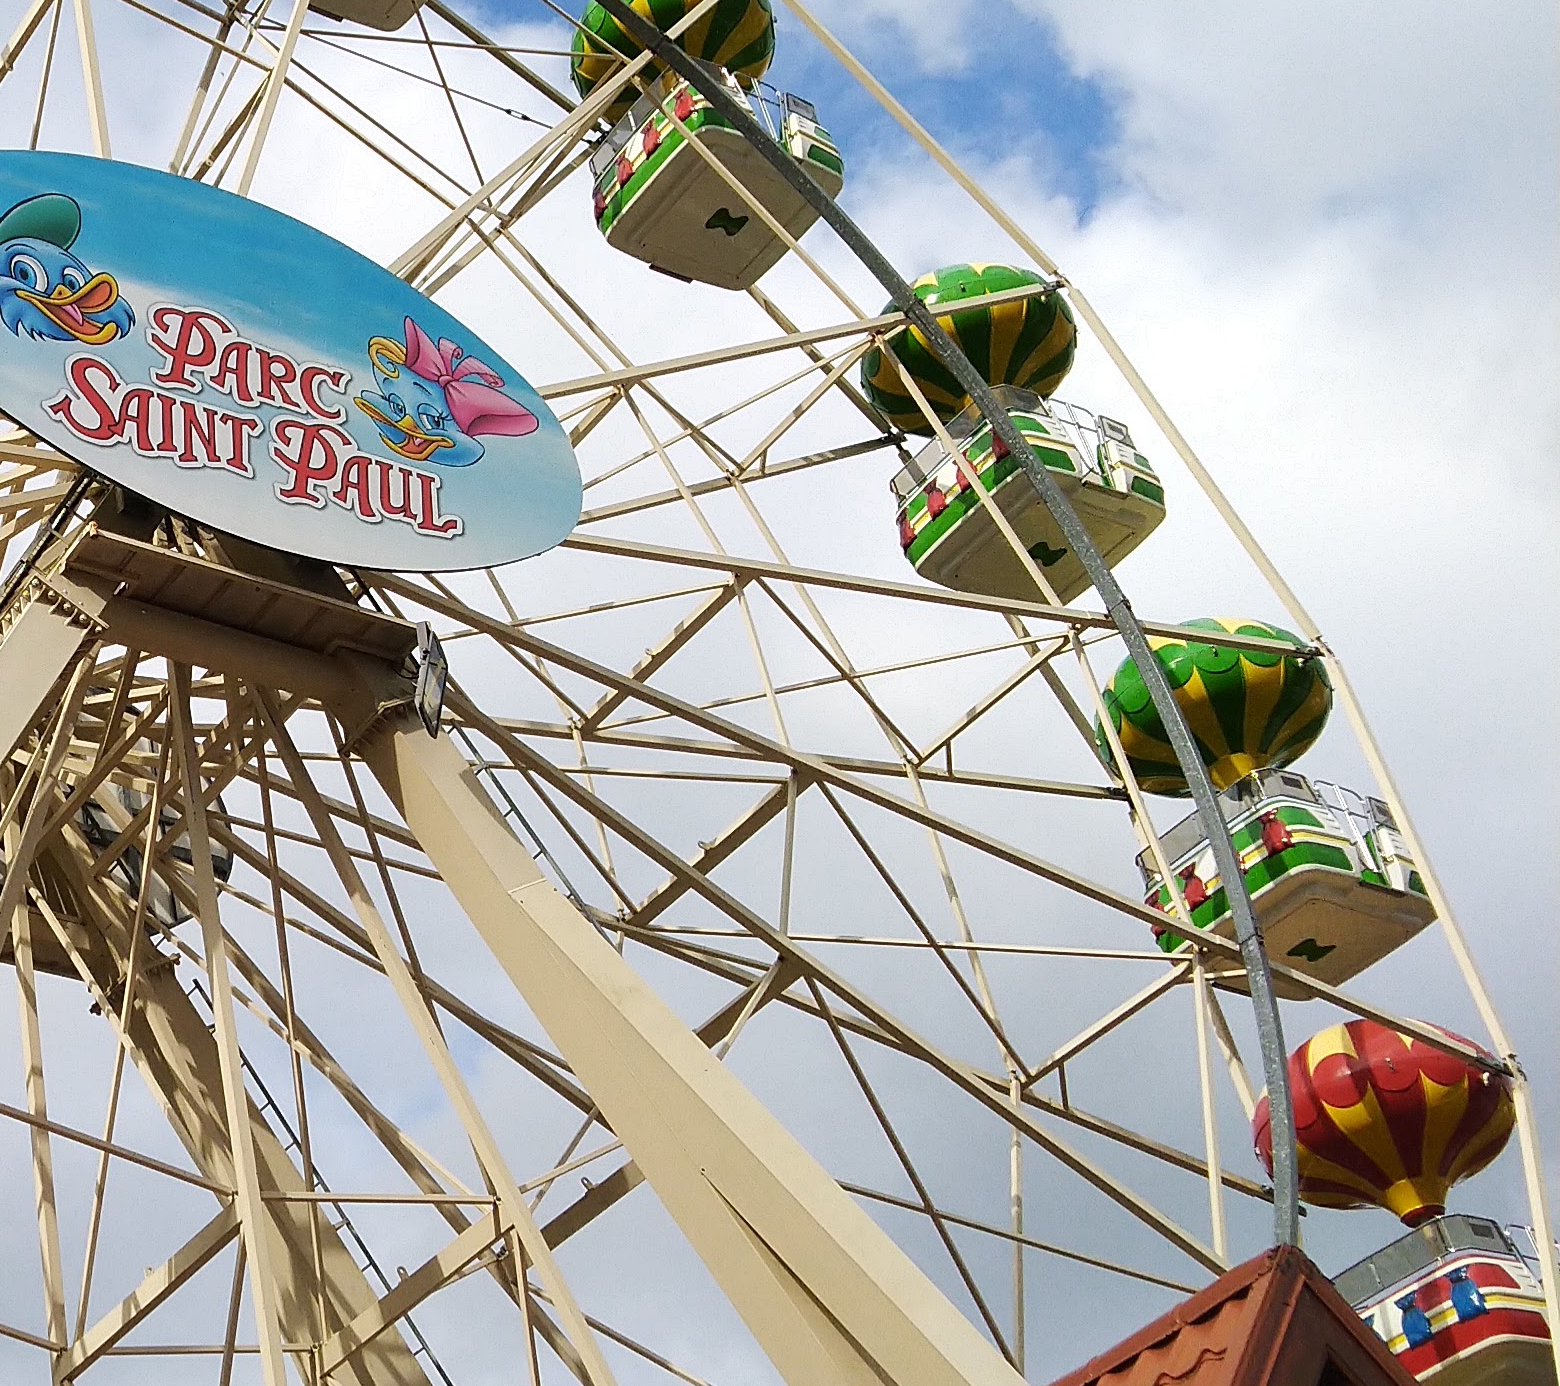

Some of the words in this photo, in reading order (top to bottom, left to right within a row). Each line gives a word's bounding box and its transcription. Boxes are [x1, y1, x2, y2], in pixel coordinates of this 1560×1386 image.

[149, 305, 347, 419] PARC
[51, 357, 257, 473] SAINT
[276, 423, 460, 534] PAUL
